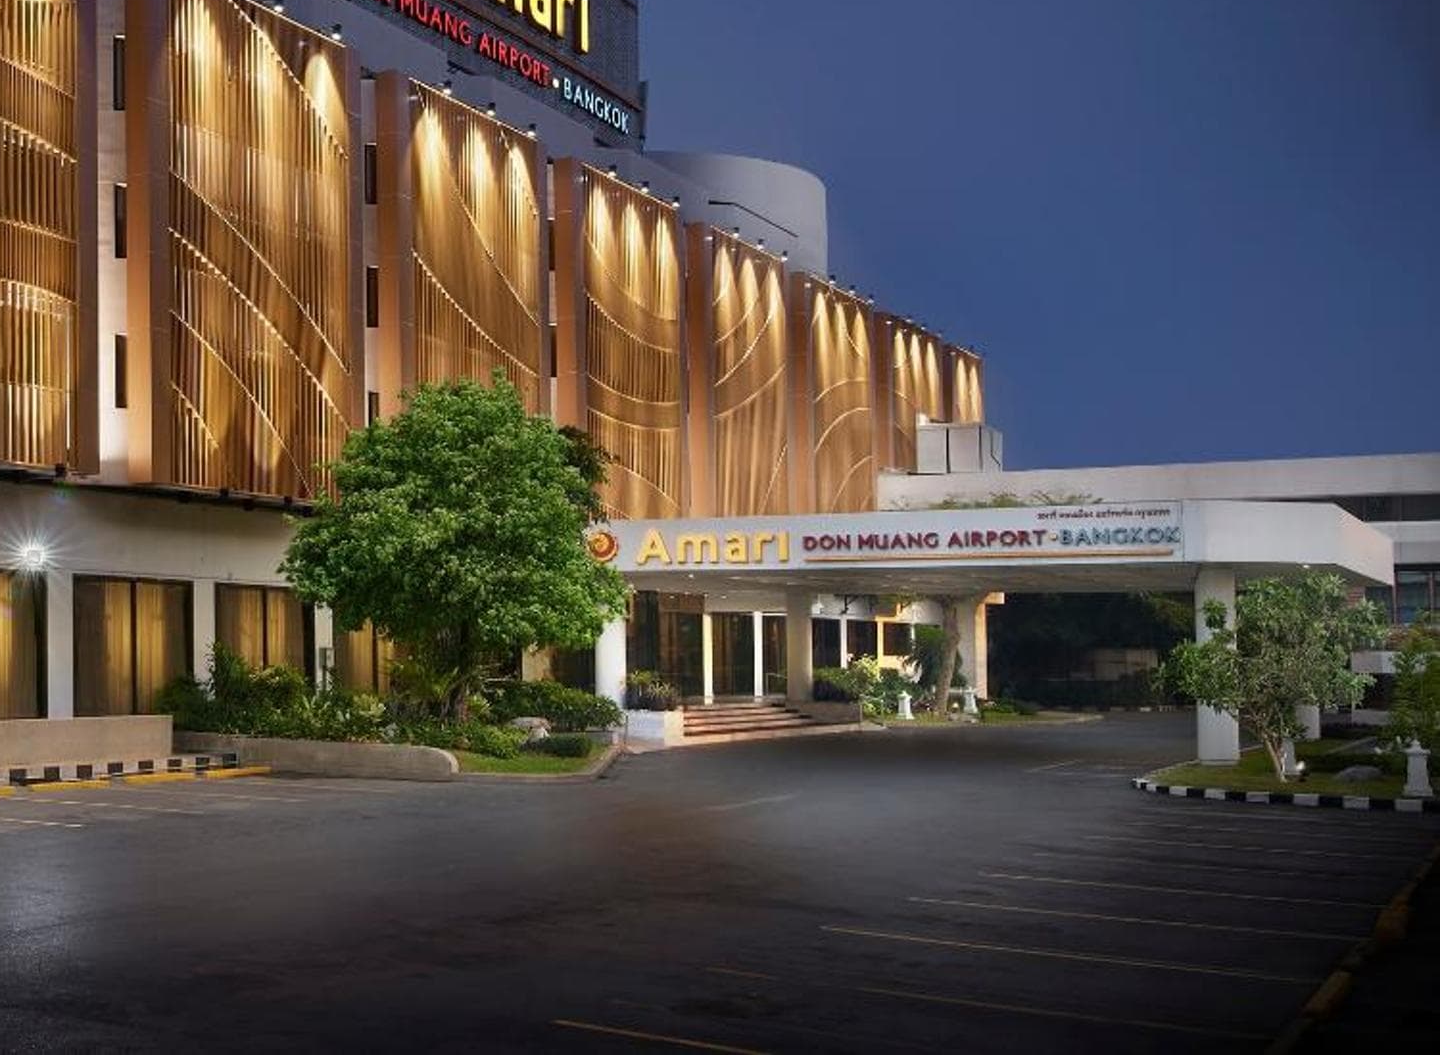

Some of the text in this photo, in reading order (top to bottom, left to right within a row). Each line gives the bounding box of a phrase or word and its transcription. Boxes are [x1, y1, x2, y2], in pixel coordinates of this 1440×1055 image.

[479, 33, 551, 86] AIRPORT
[563, 77, 629, 134] BANGKOK
[636, 527, 790, 565] Amari
[802, 526, 1181, 551] DON MUANG AIRPORT BANGKOK
